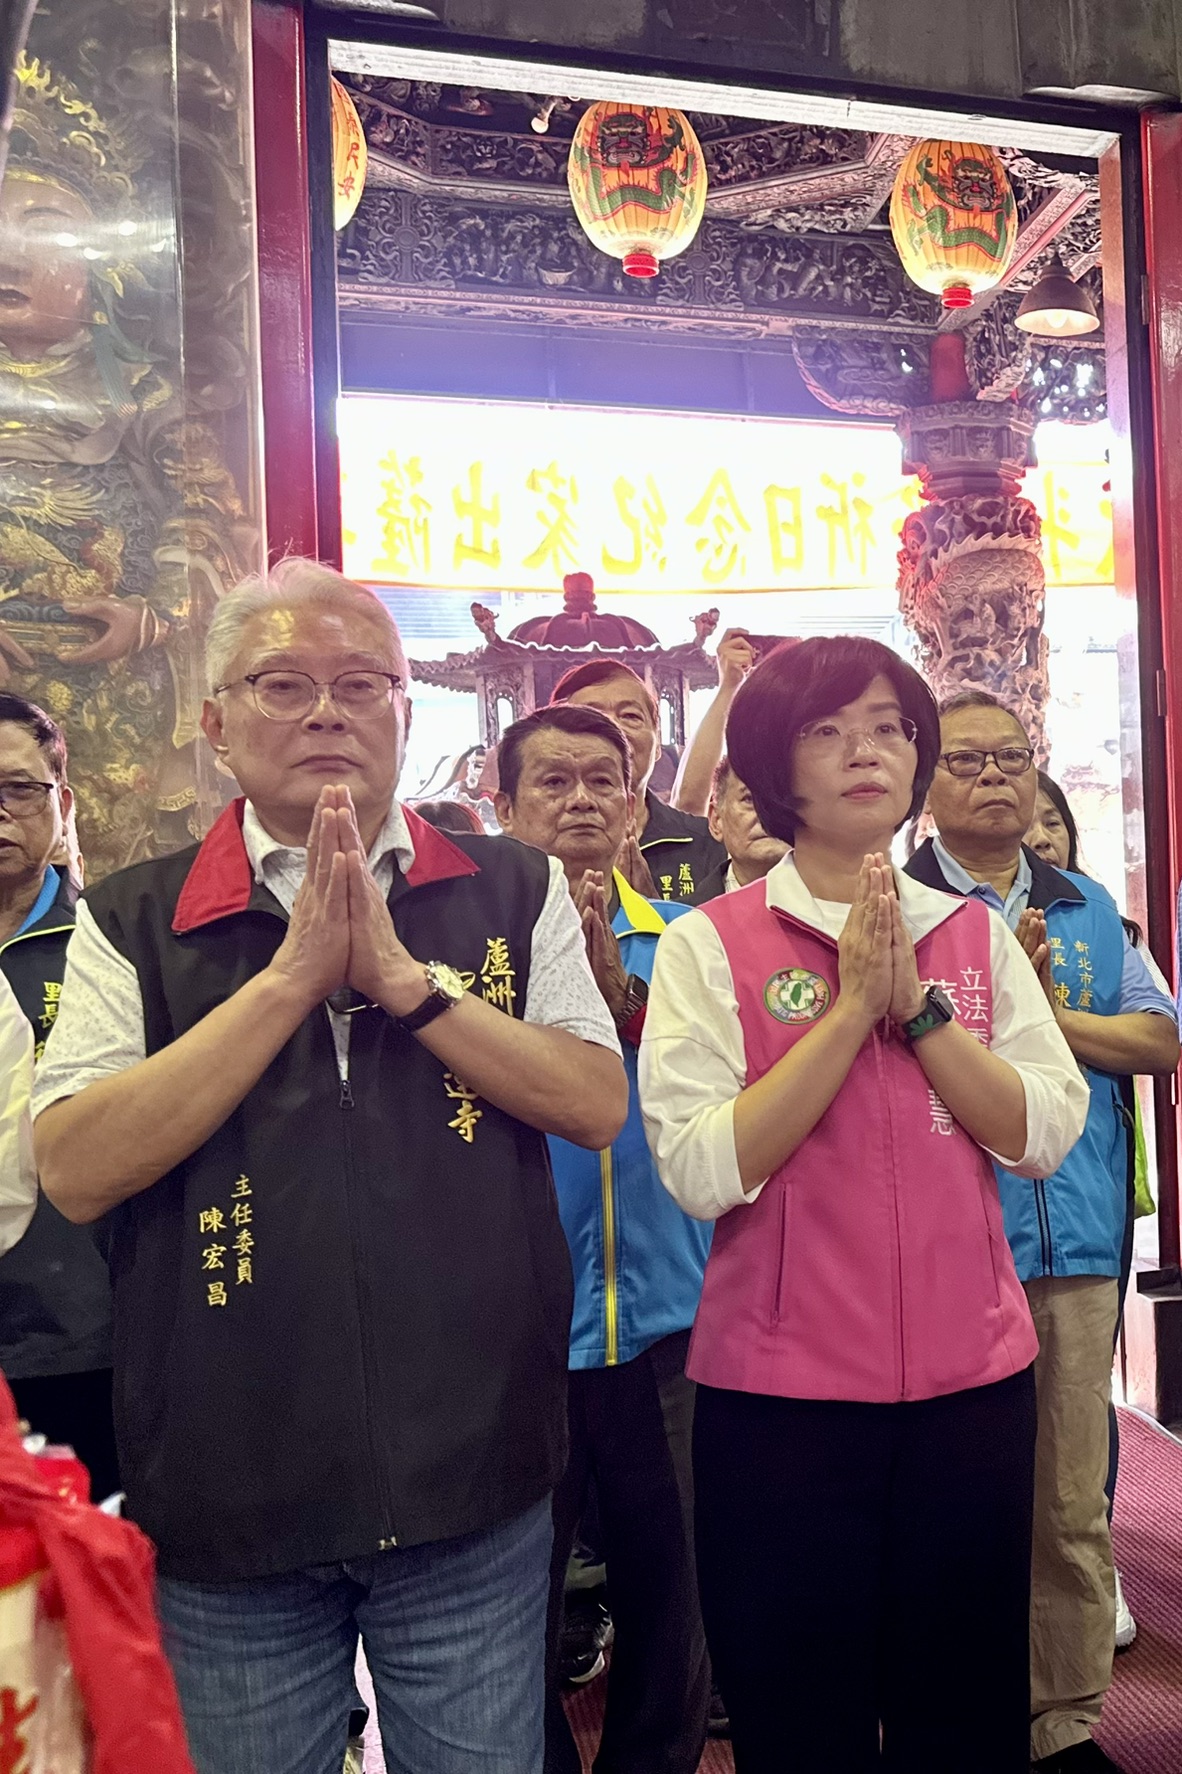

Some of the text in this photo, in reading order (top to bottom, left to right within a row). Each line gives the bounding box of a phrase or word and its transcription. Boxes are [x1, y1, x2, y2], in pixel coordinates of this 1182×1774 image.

[1074, 939, 1094, 1013] 新北市蘆
[199, 1206, 228, 1306] 陳宏昌
[230, 1174, 255, 1285] 主任委員
